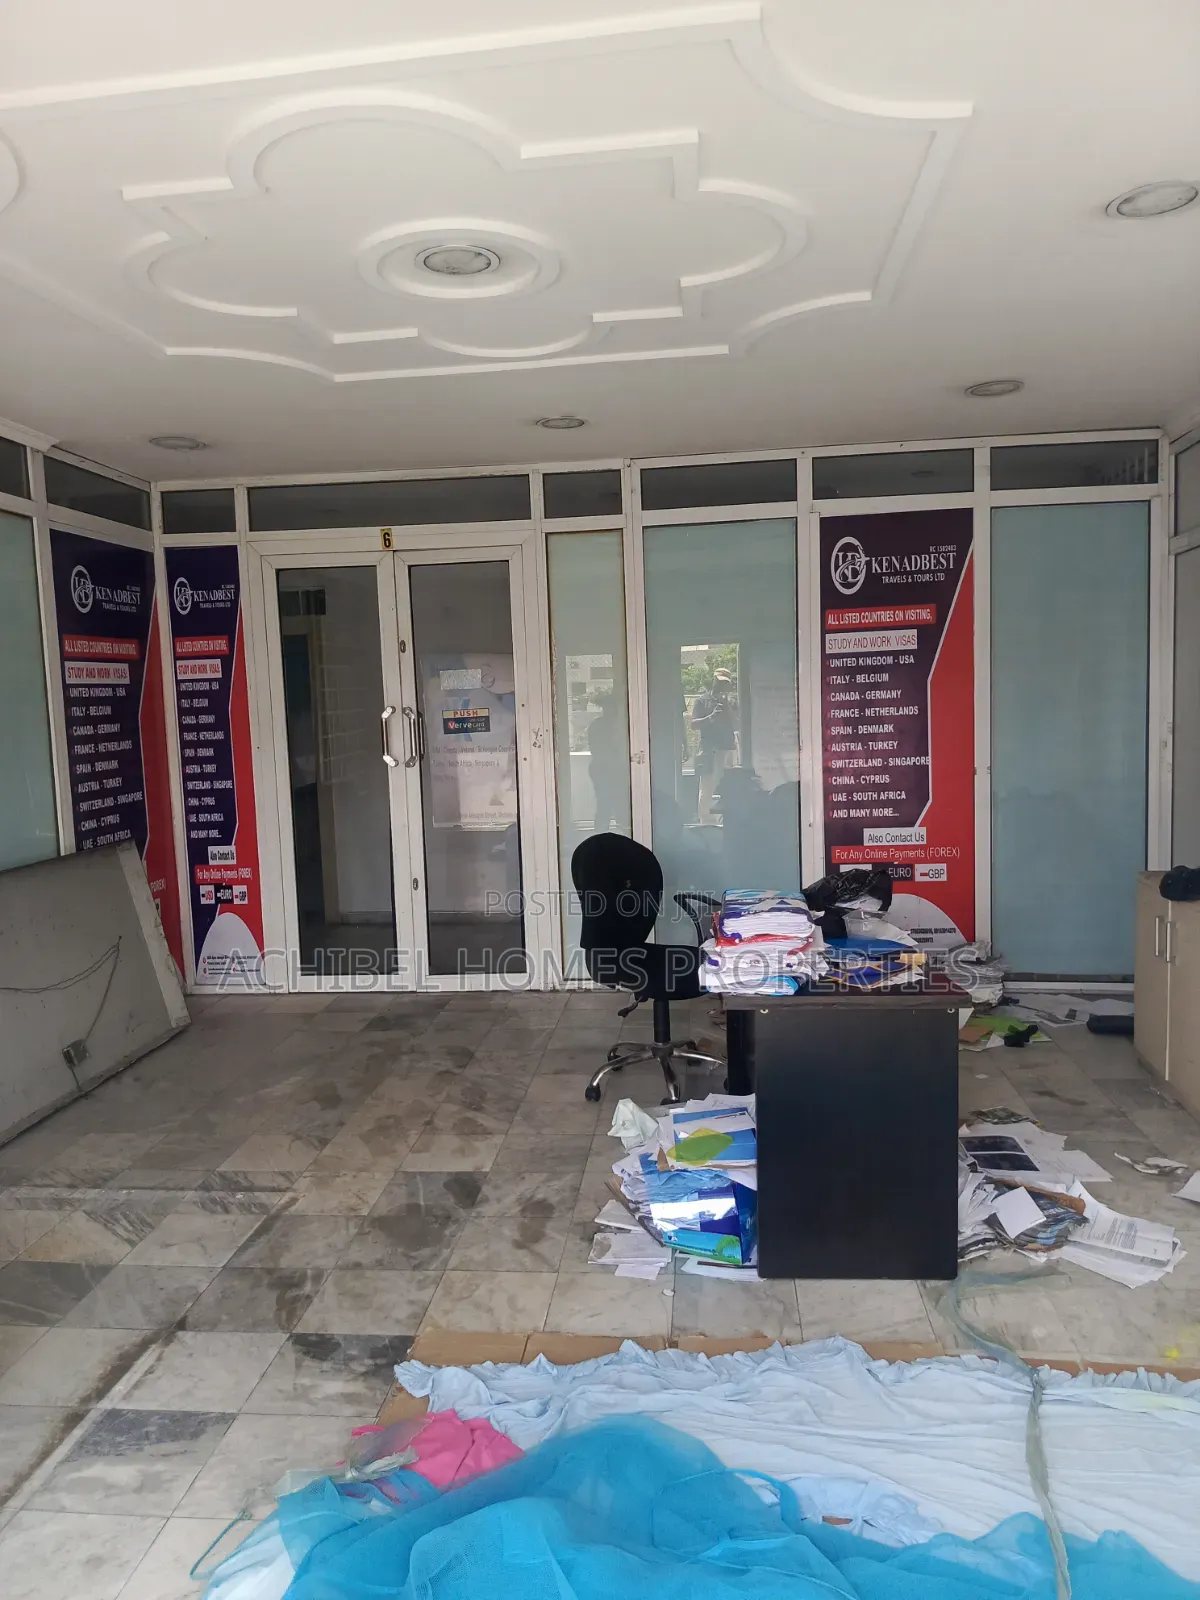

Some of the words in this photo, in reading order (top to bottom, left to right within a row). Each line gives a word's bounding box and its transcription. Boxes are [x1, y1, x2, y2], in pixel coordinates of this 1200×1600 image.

[383, 532, 391, 548] 6
[872, 552, 956, 573] KENADBEST
[882, 576, 906, 584] TRAVELS
[914, 574, 933, 582] TOURS
[95, 586, 140, 604] KENADBEST
[194, 589, 235, 602] KENADBEST
[828, 614, 839, 625] ALL
[840, 612, 860, 624] LISTED
[861, 610, 893, 623] COUNTRIES
[895, 611, 904, 621] ON
[828, 638, 852, 650] STUDY
[853, 638, 868, 649] AND
[870, 636, 891, 648] WORK
[895, 635, 916, 646] VISAS
[830, 659, 857, 667] UNITED
[859, 656, 893, 666] KINGDOM
[899, 655, 915, 664] USA
[67, 667, 84, 679] STUDY
[86, 668, 96, 679] AND
[97, 668, 111, 679] WORK
[830, 675, 850, 684] ITALY
[856, 673, 889, 683] BELGIUM
[69, 688, 90, 697] UNITED
[116, 687, 127, 697] USA
[830, 692, 860, 701] CANADA
[865, 690, 902, 700] GERMANY
[71, 706, 86, 716] ITALY
[90, 705, 112, 716] BELGIUM
[830, 709, 860, 718] FRANCE
[865, 706, 919, 717] NETHERLANDS
[73, 725, 94, 736] CANADA
[97, 723, 121, 734] GERMANY
[448, 721, 472, 730] Verve
[831, 726, 852, 735] SPAIN
[858, 724, 894, 734] DENMARK
[74, 743, 95, 755] FRANCE
[98, 740, 132, 752] NETHERLANDS
[831, 742, 863, 751] AUSTRIA
[868, 741, 898, 750] TURKEY
[76, 763, 91, 774] SPAIN
[95, 760, 119, 771] DENMARK
[831, 758, 883, 768] SWITZERLAND
[888, 756, 930, 766] SINGAPORE
[78, 781, 100, 793] AUSTRIA
[103, 777, 122, 789] TURKEY
[832, 776, 855, 785] CHINA
[860, 775, 890, 784] CYPRUS
[79, 797, 114, 812] SWITZERLAND
[117, 791, 143, 804] SINGAPORE
[832, 793, 847, 801] UAE
[852, 791, 878, 801] SOUTH
[879, 790, 906, 800] AFRICA
[832, 809, 848, 818] AND
[849, 808, 871, 817] MANY
[80, 819, 98, 831] CHINA
[100, 814, 119, 826] CYPRUS
[82, 839, 94, 850] UAE
[96, 833, 114, 846] SOUTH
[114, 829, 131, 841] AFRICA
[867, 833, 883, 843] Also
[885, 831, 913, 842] Contact
[914, 832, 925, 842] Us
[835, 849, 848, 860] For
[849, 849, 863, 861] Any
[864, 848, 888, 859] Online
[889, 847, 925, 861] Payments
[926, 847, 960, 859] (FOREX)
[888, 867, 912, 878] EURO
[928, 869, 945, 879] GBP
